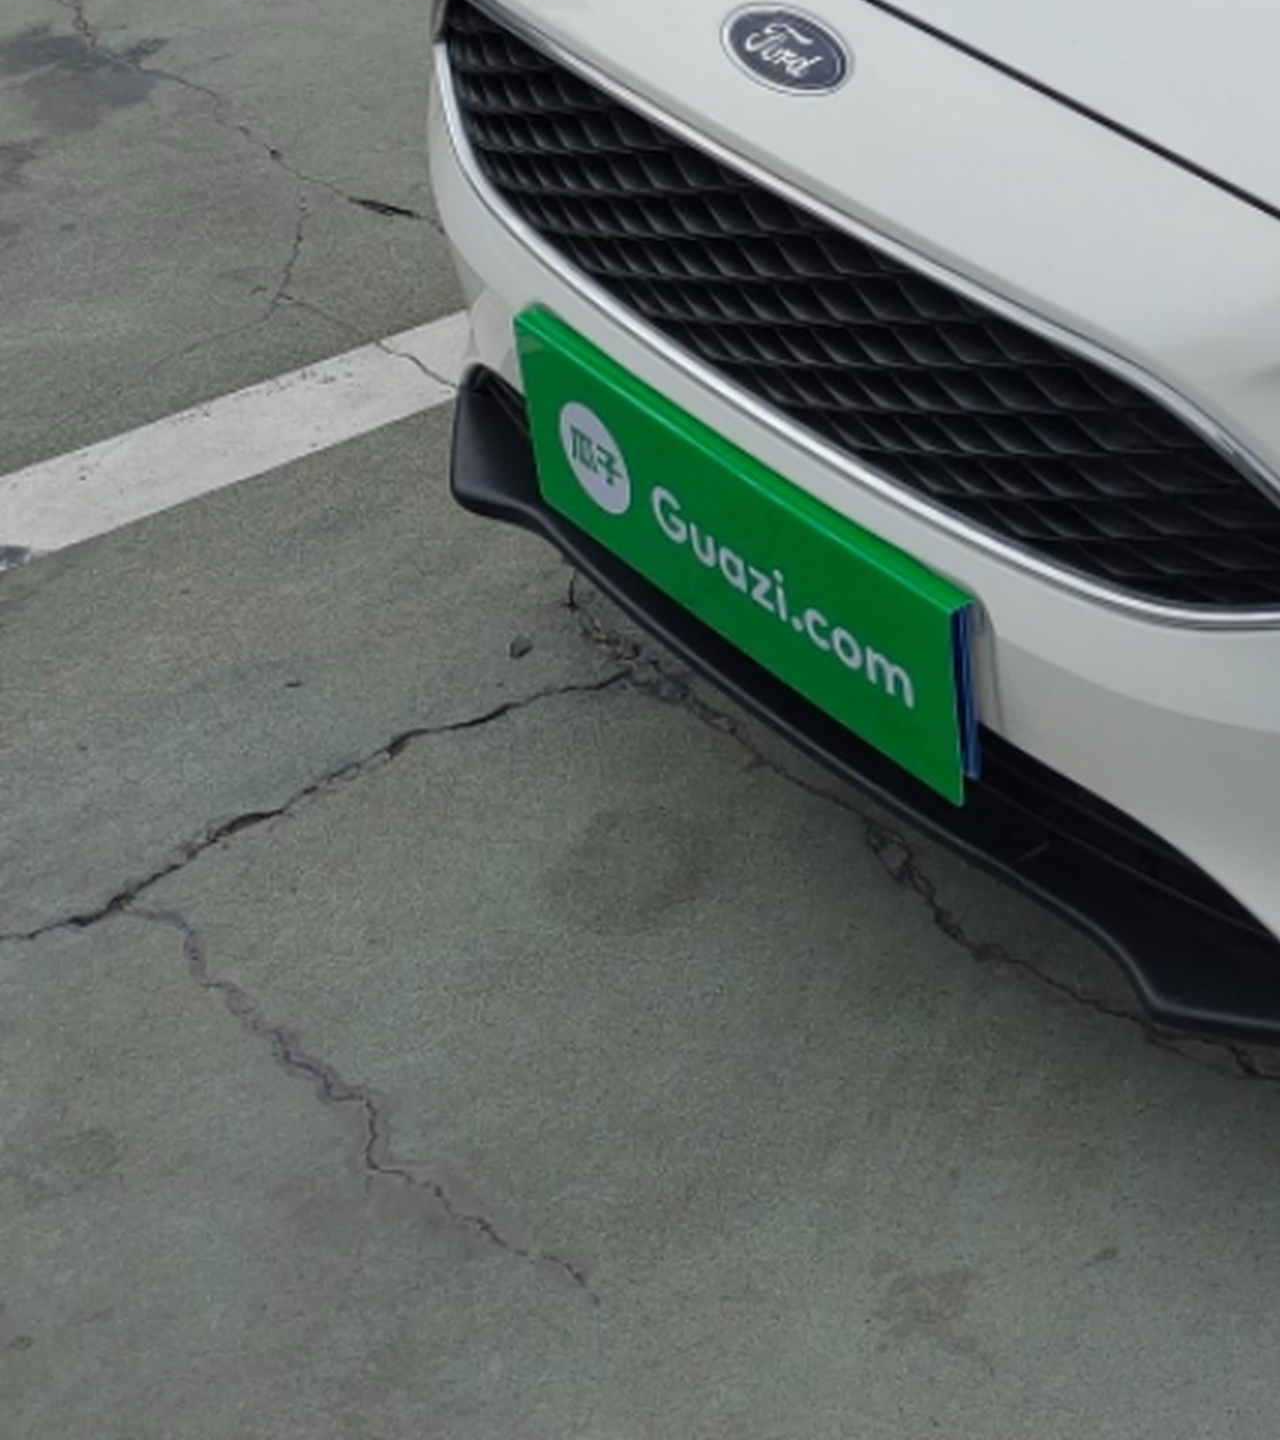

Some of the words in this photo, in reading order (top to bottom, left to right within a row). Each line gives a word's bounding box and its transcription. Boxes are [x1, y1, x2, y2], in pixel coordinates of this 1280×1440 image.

[745, 22, 823, 79] Ford
[567, 424, 624, 488] 瓜子
[651, 486, 914, 709] Guazi.com
